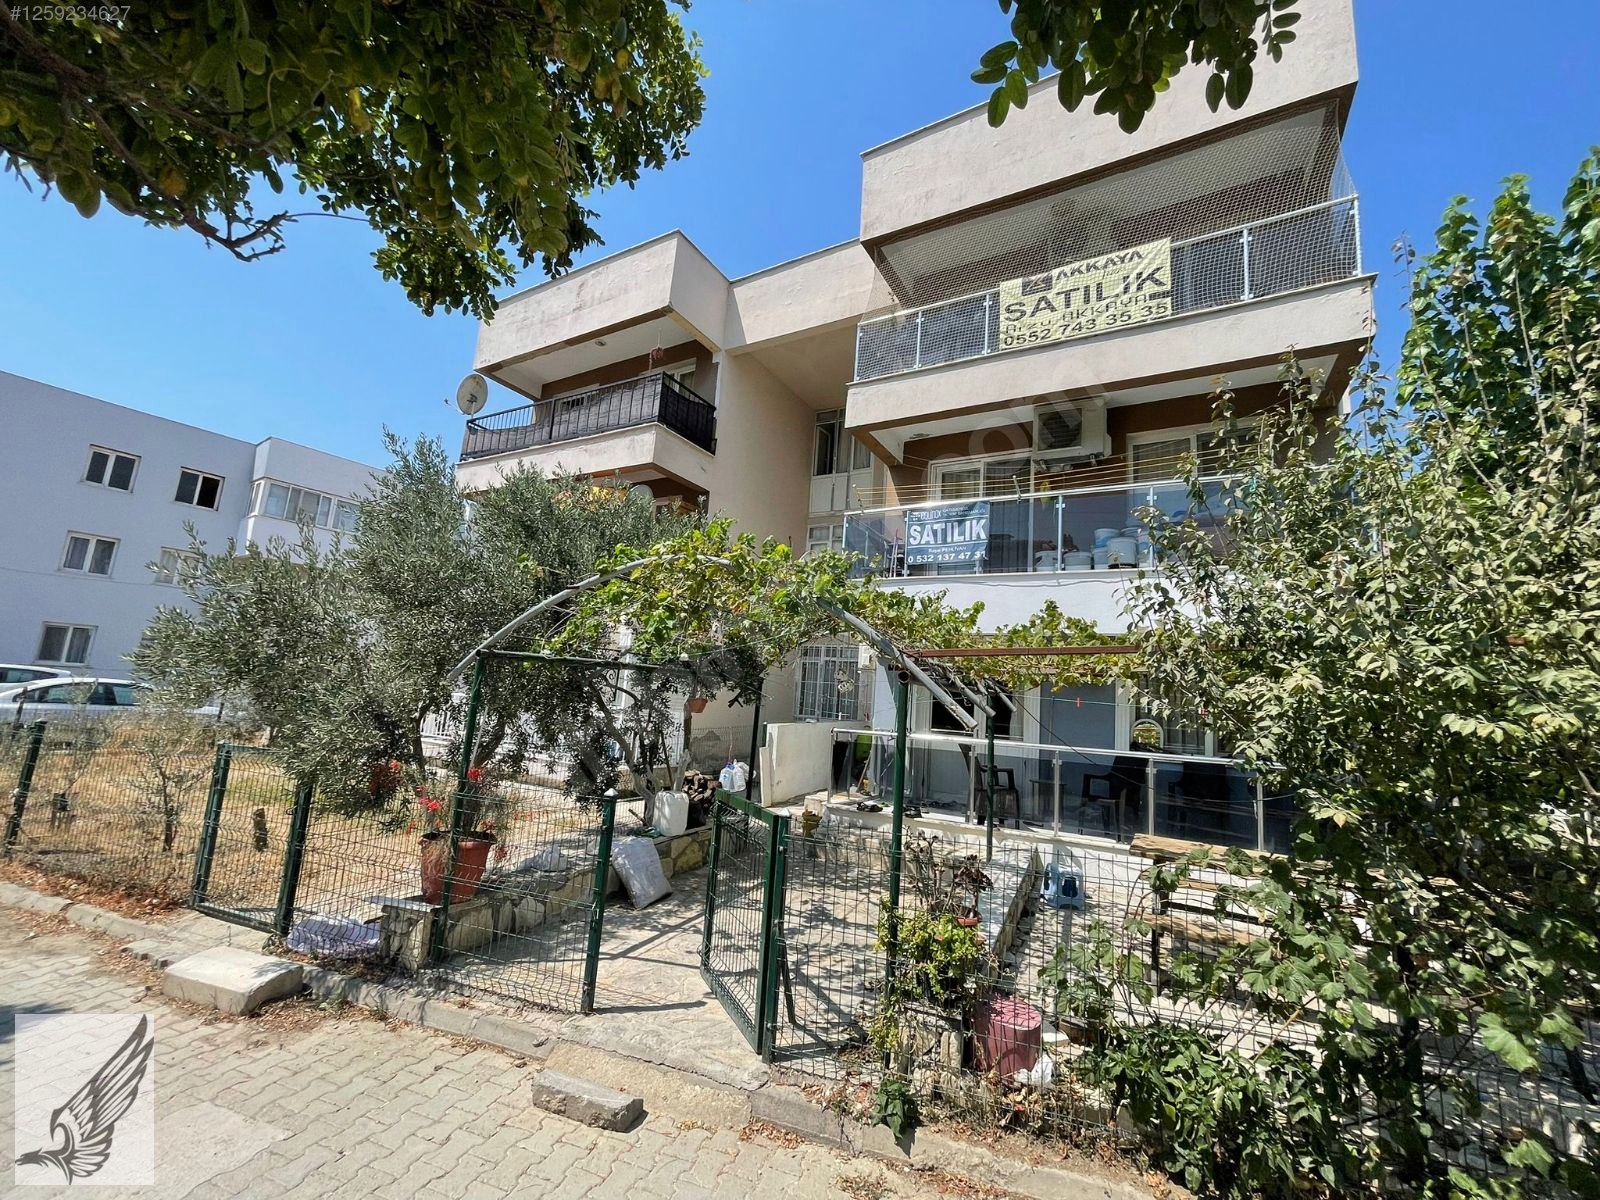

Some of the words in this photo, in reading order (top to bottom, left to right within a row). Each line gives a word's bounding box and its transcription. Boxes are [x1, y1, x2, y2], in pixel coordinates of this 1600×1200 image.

[1056, 250, 1144, 281] AKKAYA
[1003, 266, 1167, 322] SATILIK
[1003, 328, 1051, 346] 0552
[1059, 318, 1097, 336] 743
[1105, 311, 1132, 326] 35
[1140, 302, 1168, 318] 35
[909, 519, 987, 545] SATILIK
[916, 554, 934, 562] 532
[937, 553, 955, 561] 137
[958, 552, 971, 560] 47
